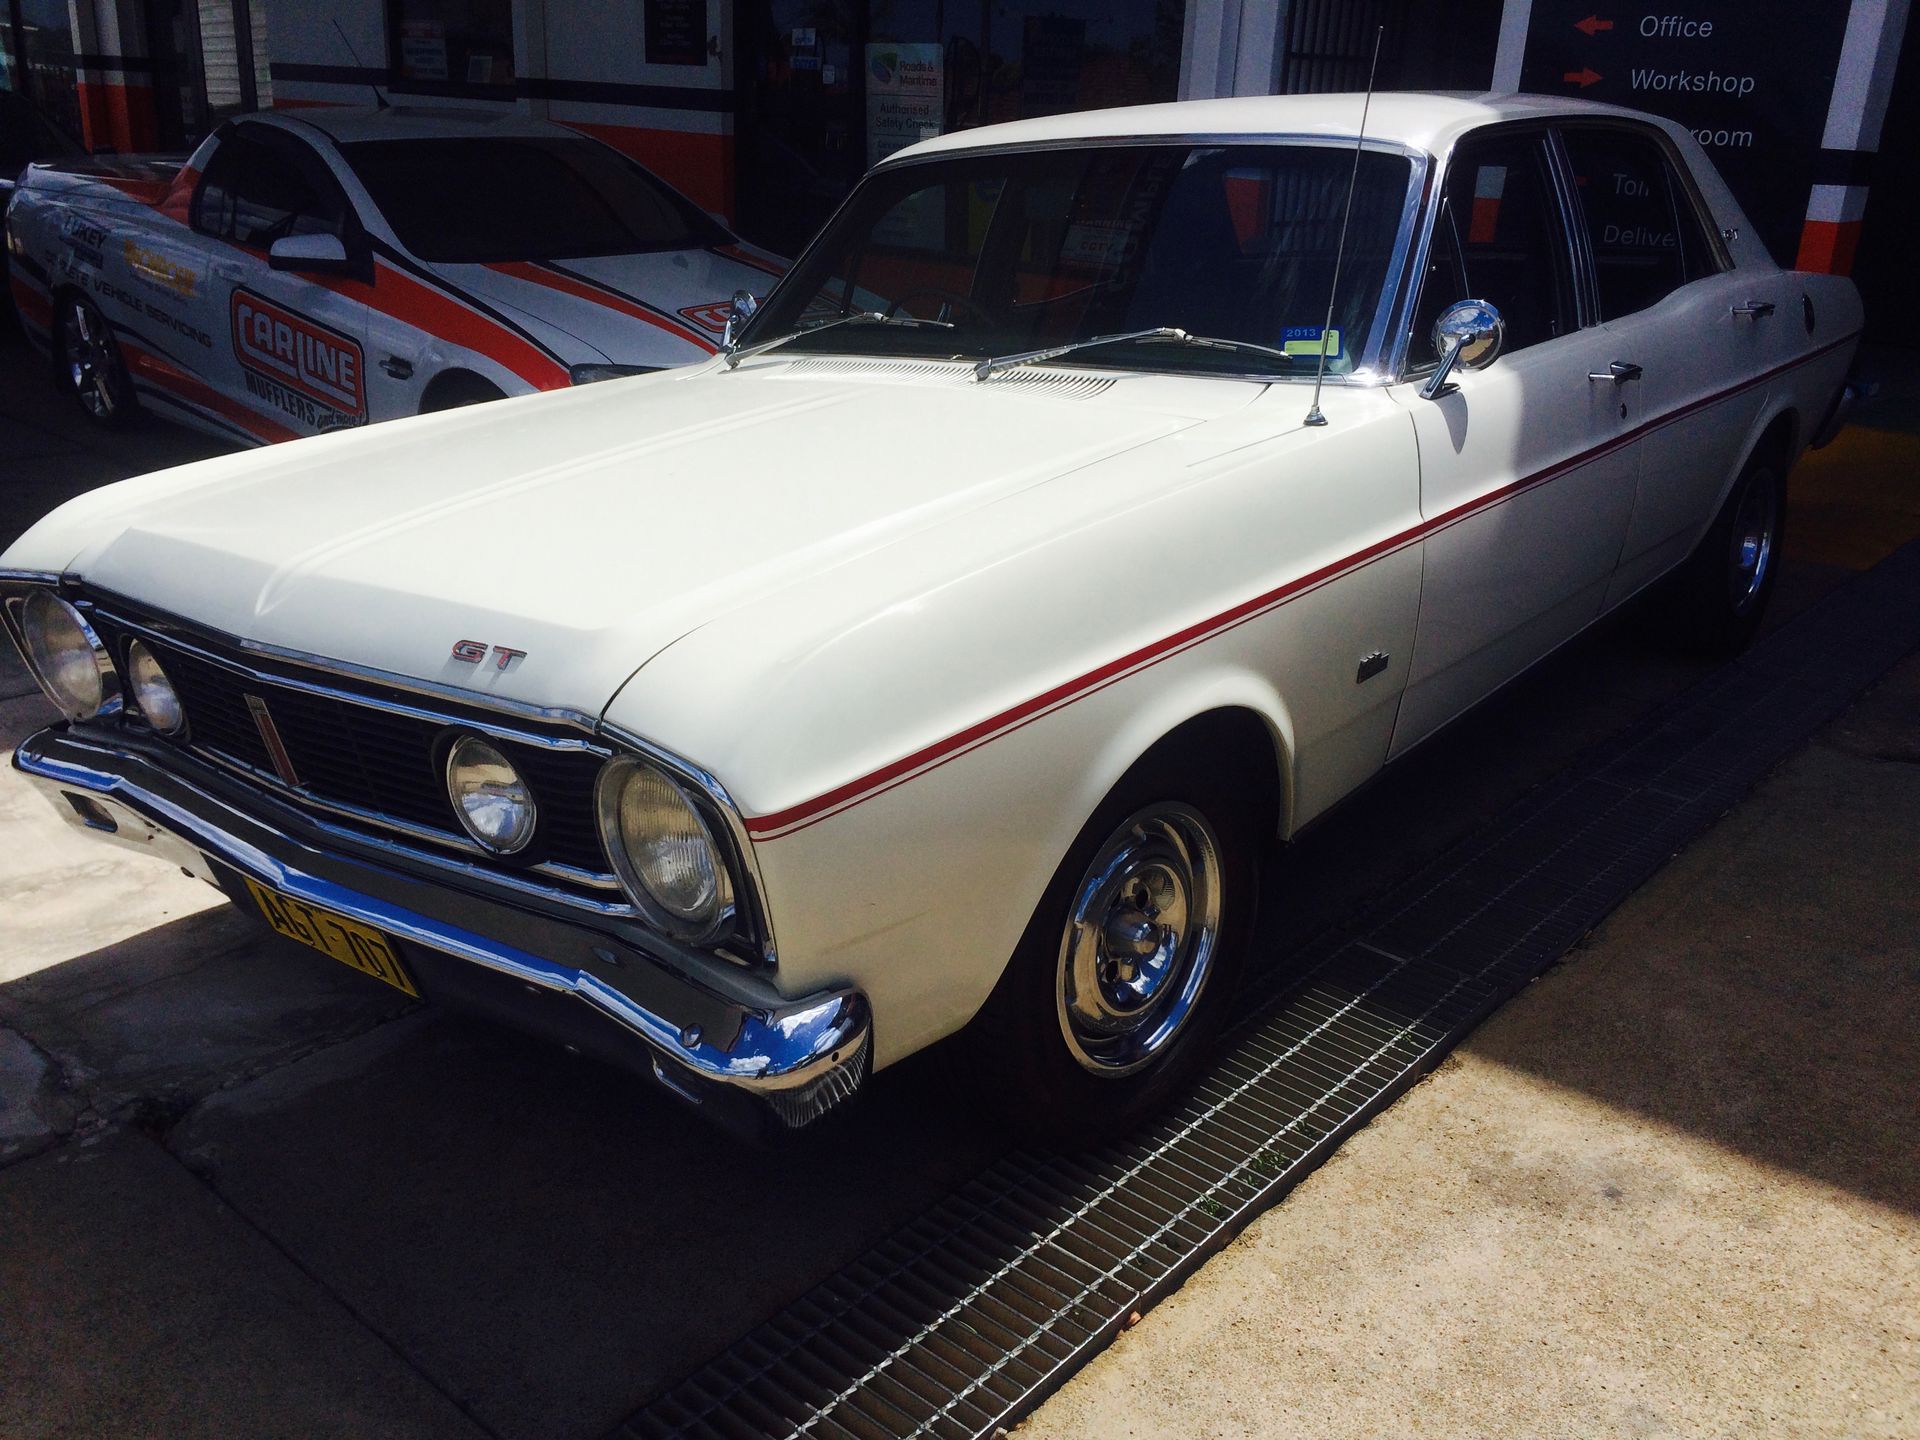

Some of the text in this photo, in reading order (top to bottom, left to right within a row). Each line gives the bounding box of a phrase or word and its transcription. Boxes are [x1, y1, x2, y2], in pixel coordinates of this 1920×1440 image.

[1640, 15, 1713, 38] Office
[1630, 69, 1755, 98] Workshop
[1286, 328, 1316, 338] 2013
[237, 301, 357, 409] CARLINE
[452, 640, 528, 671] GT
